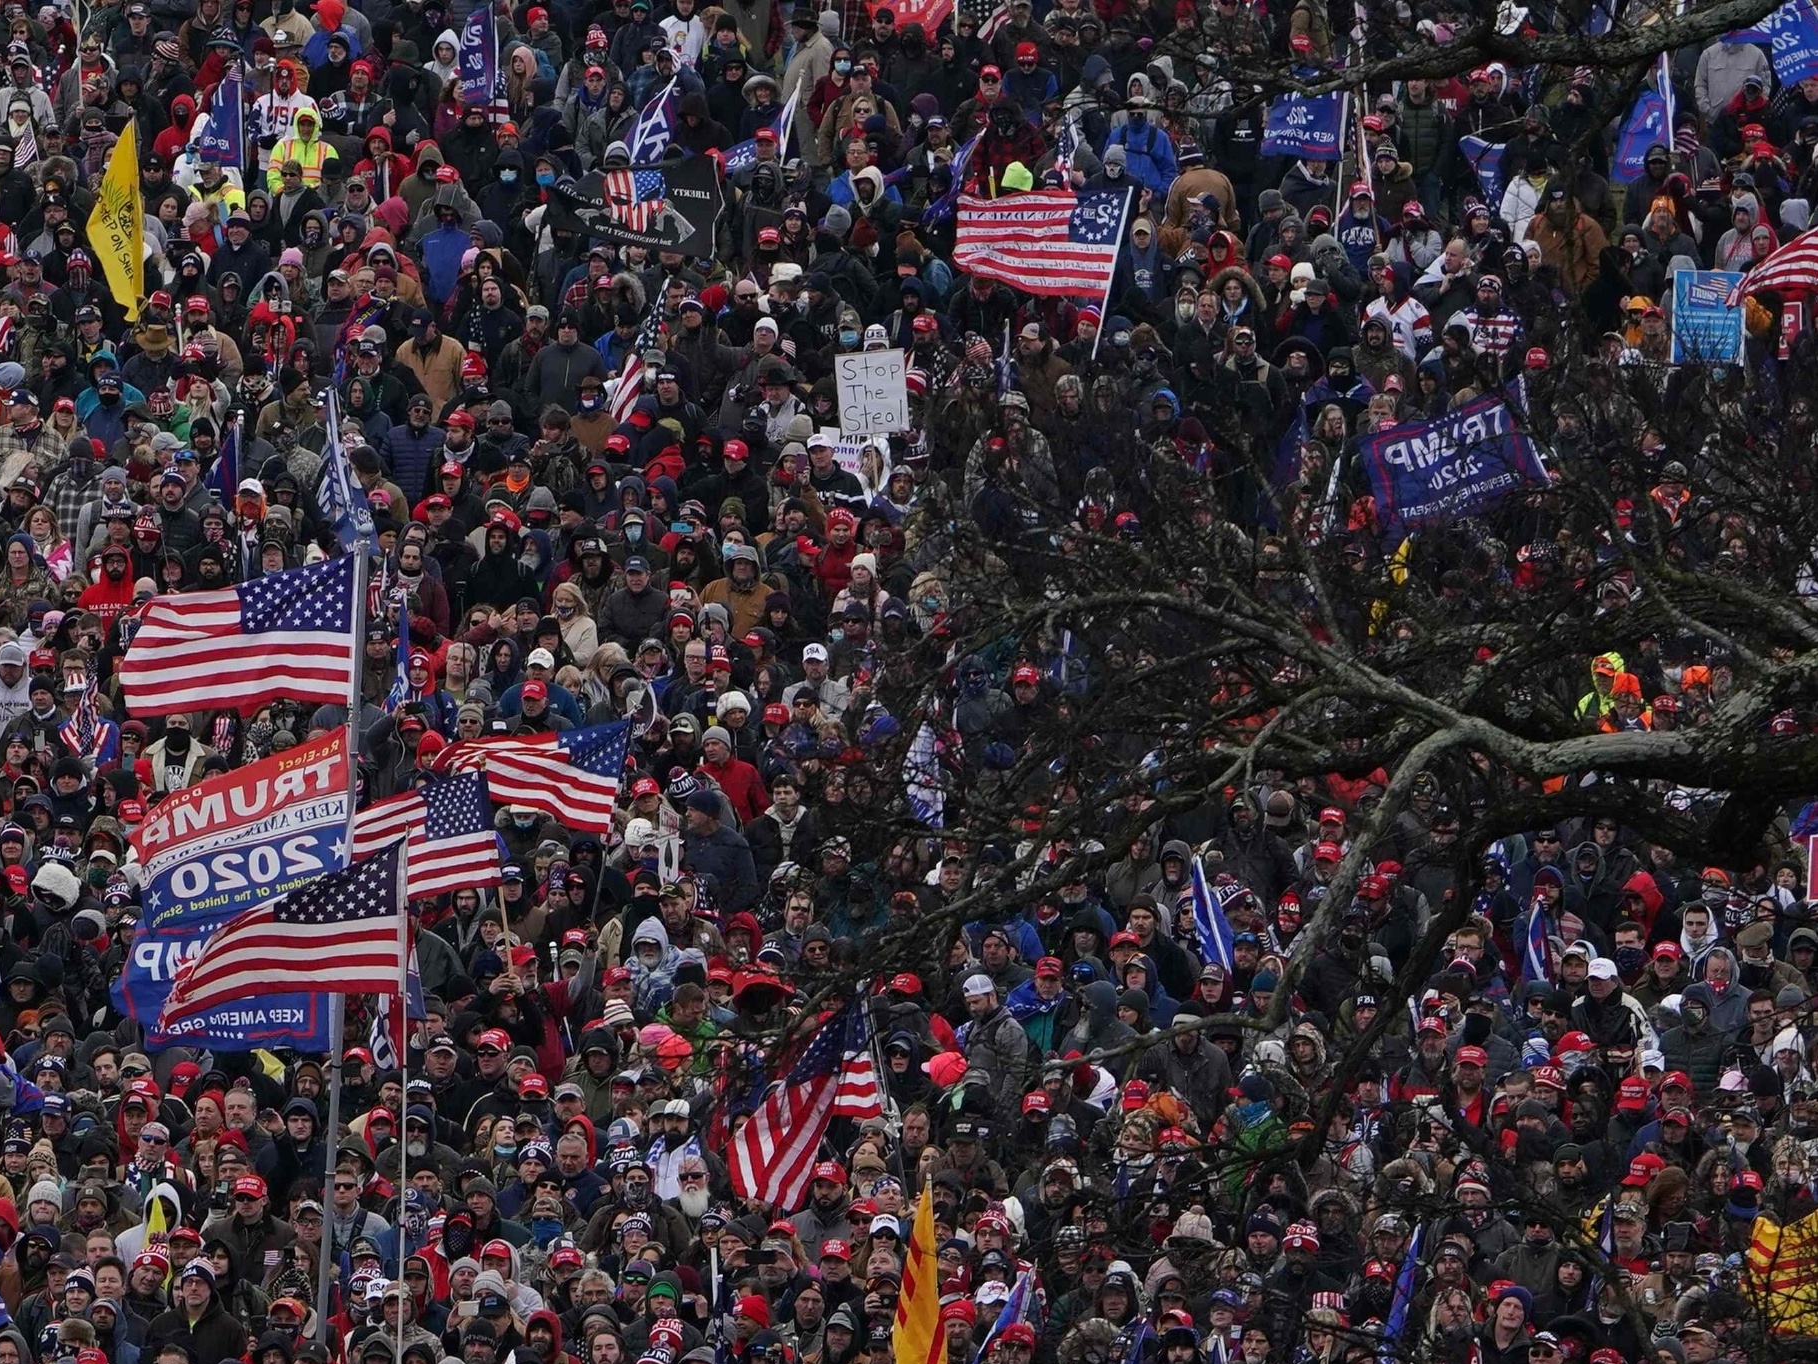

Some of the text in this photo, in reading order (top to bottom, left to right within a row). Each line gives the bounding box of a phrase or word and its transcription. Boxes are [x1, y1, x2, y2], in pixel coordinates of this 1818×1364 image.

[111, 235, 125, 253] ON
[842, 357, 900, 381] Stop
[846, 384, 888, 402] The
[844, 399, 902, 431] Steal
[1357, 996, 1375, 1005] FBI
[623, 1222, 643, 1231] 2020
